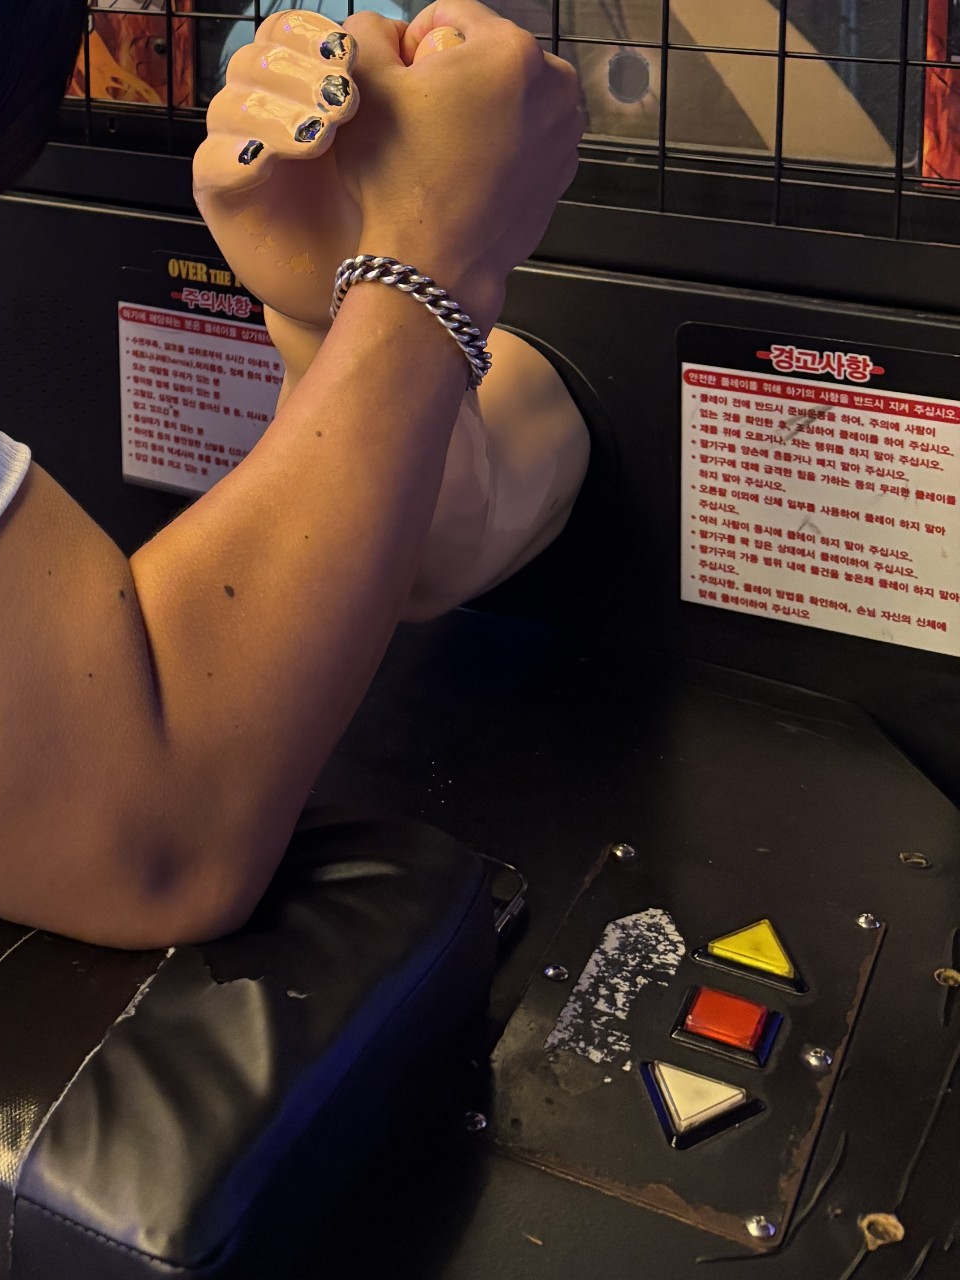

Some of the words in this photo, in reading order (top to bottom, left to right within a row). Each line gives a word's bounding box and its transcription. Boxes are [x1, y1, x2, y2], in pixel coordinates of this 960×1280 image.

[168, 258, 208, 283] OVER
[209, 268, 232, 287] THE
[181, 286, 253, 318] 주의사항
[769, 343, 874, 383] 경고사항
[688, 370, 717, 386] 안전한
[721, 375, 758, 392] 플레이를
[763, 381, 781, 396] 위해
[786, 384, 815, 401] 하기의
[819, 389, 849, 406] 사항을
[853, 394, 884, 411] 반드시
[889, 399, 909, 414] 지켜
[699, 393, 728, 406] 플레이
[732, 398, 751, 410] 전에
[755, 401, 783, 415] 반드시
[787, 406, 836, 422] 준비운동을
[904, 424, 936, 438] 사람이
[699, 408, 718, 420] 없는
[723, 412, 741, 423] 것을
[745, 415, 774, 428] 확인한
[796, 422, 835, 440] 조심하여
[839, 429, 879, 445] 플레이를
[884, 436, 904, 449] 하여
[700, 438, 736, 454] 팔기구를
[840, 461, 861, 474] 말아
[723, 427, 741, 439] 위에
[789, 437, 811, 450] 차는
[815, 441, 844, 455] 행위를
[849, 447, 869, 459] 하지
[874, 451, 895, 463] 말아
[699, 468, 718, 481] 하지
[722, 473, 741, 485] 말아
[699, 454, 736, 469] 팔기구에
[741, 461, 759, 473] 대해
[821, 474, 850, 488] 가하는
[854, 479, 875, 492] 등의
[879, 484, 910, 500] 무리한
[914, 489, 957, 506] 플레이를
[699, 484, 727, 497] 오른팔
[731, 490, 759, 503] 이외에
[764, 496, 783, 507] 신체
[787, 499, 816, 513] 일부를
[820, 505, 860, 521] 사용하여
[864, 513, 895, 527] 플레이
[899, 519, 920, 532] 하지
[924, 523, 946, 536] 말아
[699, 514, 717, 526] 여러
[722, 519, 750, 532] 사람이
[753, 524, 783, 538] 동시에
[786, 529, 816, 544] 플레이
[820, 536, 840, 549] 하지
[844, 540, 865, 553] 말아
[699, 529, 736, 545] 팔기구를
[754, 539, 773, 552] 잡은
[777, 544, 816, 560] 상태에서
[820, 552, 869, 569] 플레이하여
[699, 544, 736, 560] 팔기구의
[740, 552, 759, 564] 가동
[763, 556, 782, 569] 범위
[786, 561, 806, 573] 내에
[878, 578, 909, 593] 플레이
[913, 585, 934, 598] 하지
[939, 589, 960, 603] 말아
[721, 593, 768, 611] 플레이하여
[772, 603, 810, 620] 주십시오
[743, 583, 771, 597] 플레이
[776, 589, 804, 603] 방법을
[856, 605, 876, 618] 손님
[880, 610, 911, 625] 자신의
[916, 617, 947, 632] 신체에
